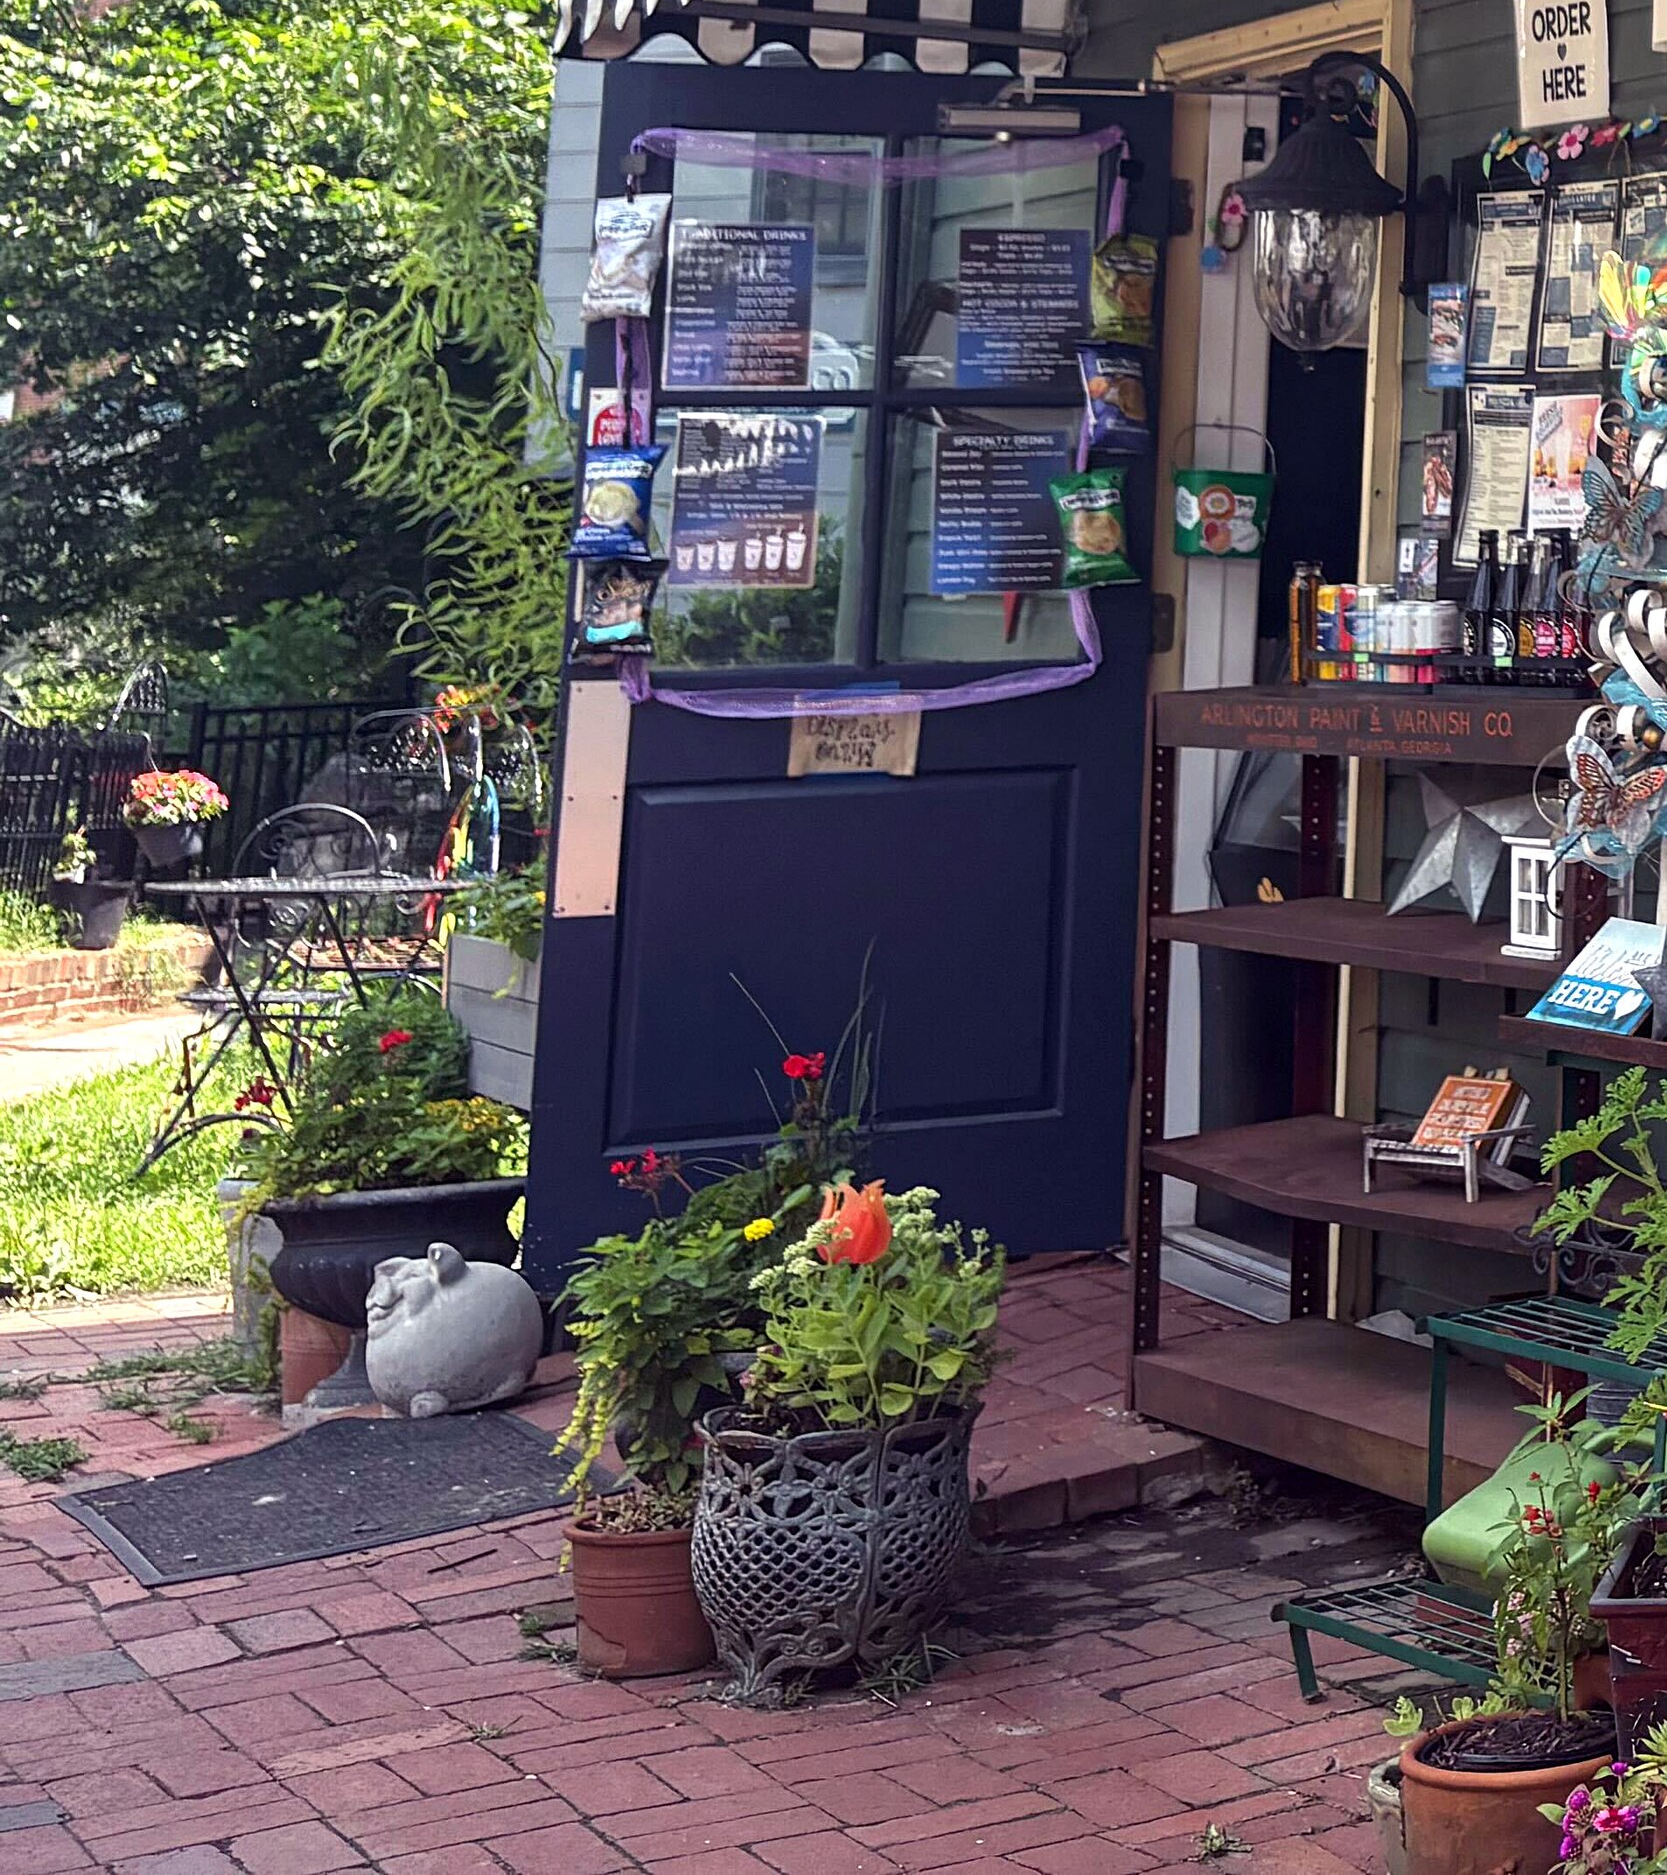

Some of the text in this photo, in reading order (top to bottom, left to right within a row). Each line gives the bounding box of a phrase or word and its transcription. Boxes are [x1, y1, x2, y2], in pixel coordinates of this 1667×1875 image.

[1532, 1, 1592, 43] ORDER
[1542, 64, 1587, 103] HERE
[1310, 706, 1360, 732] PAINT
[1393, 709, 1471, 737] VARNISH
[1547, 979, 1622, 1015] HERE
